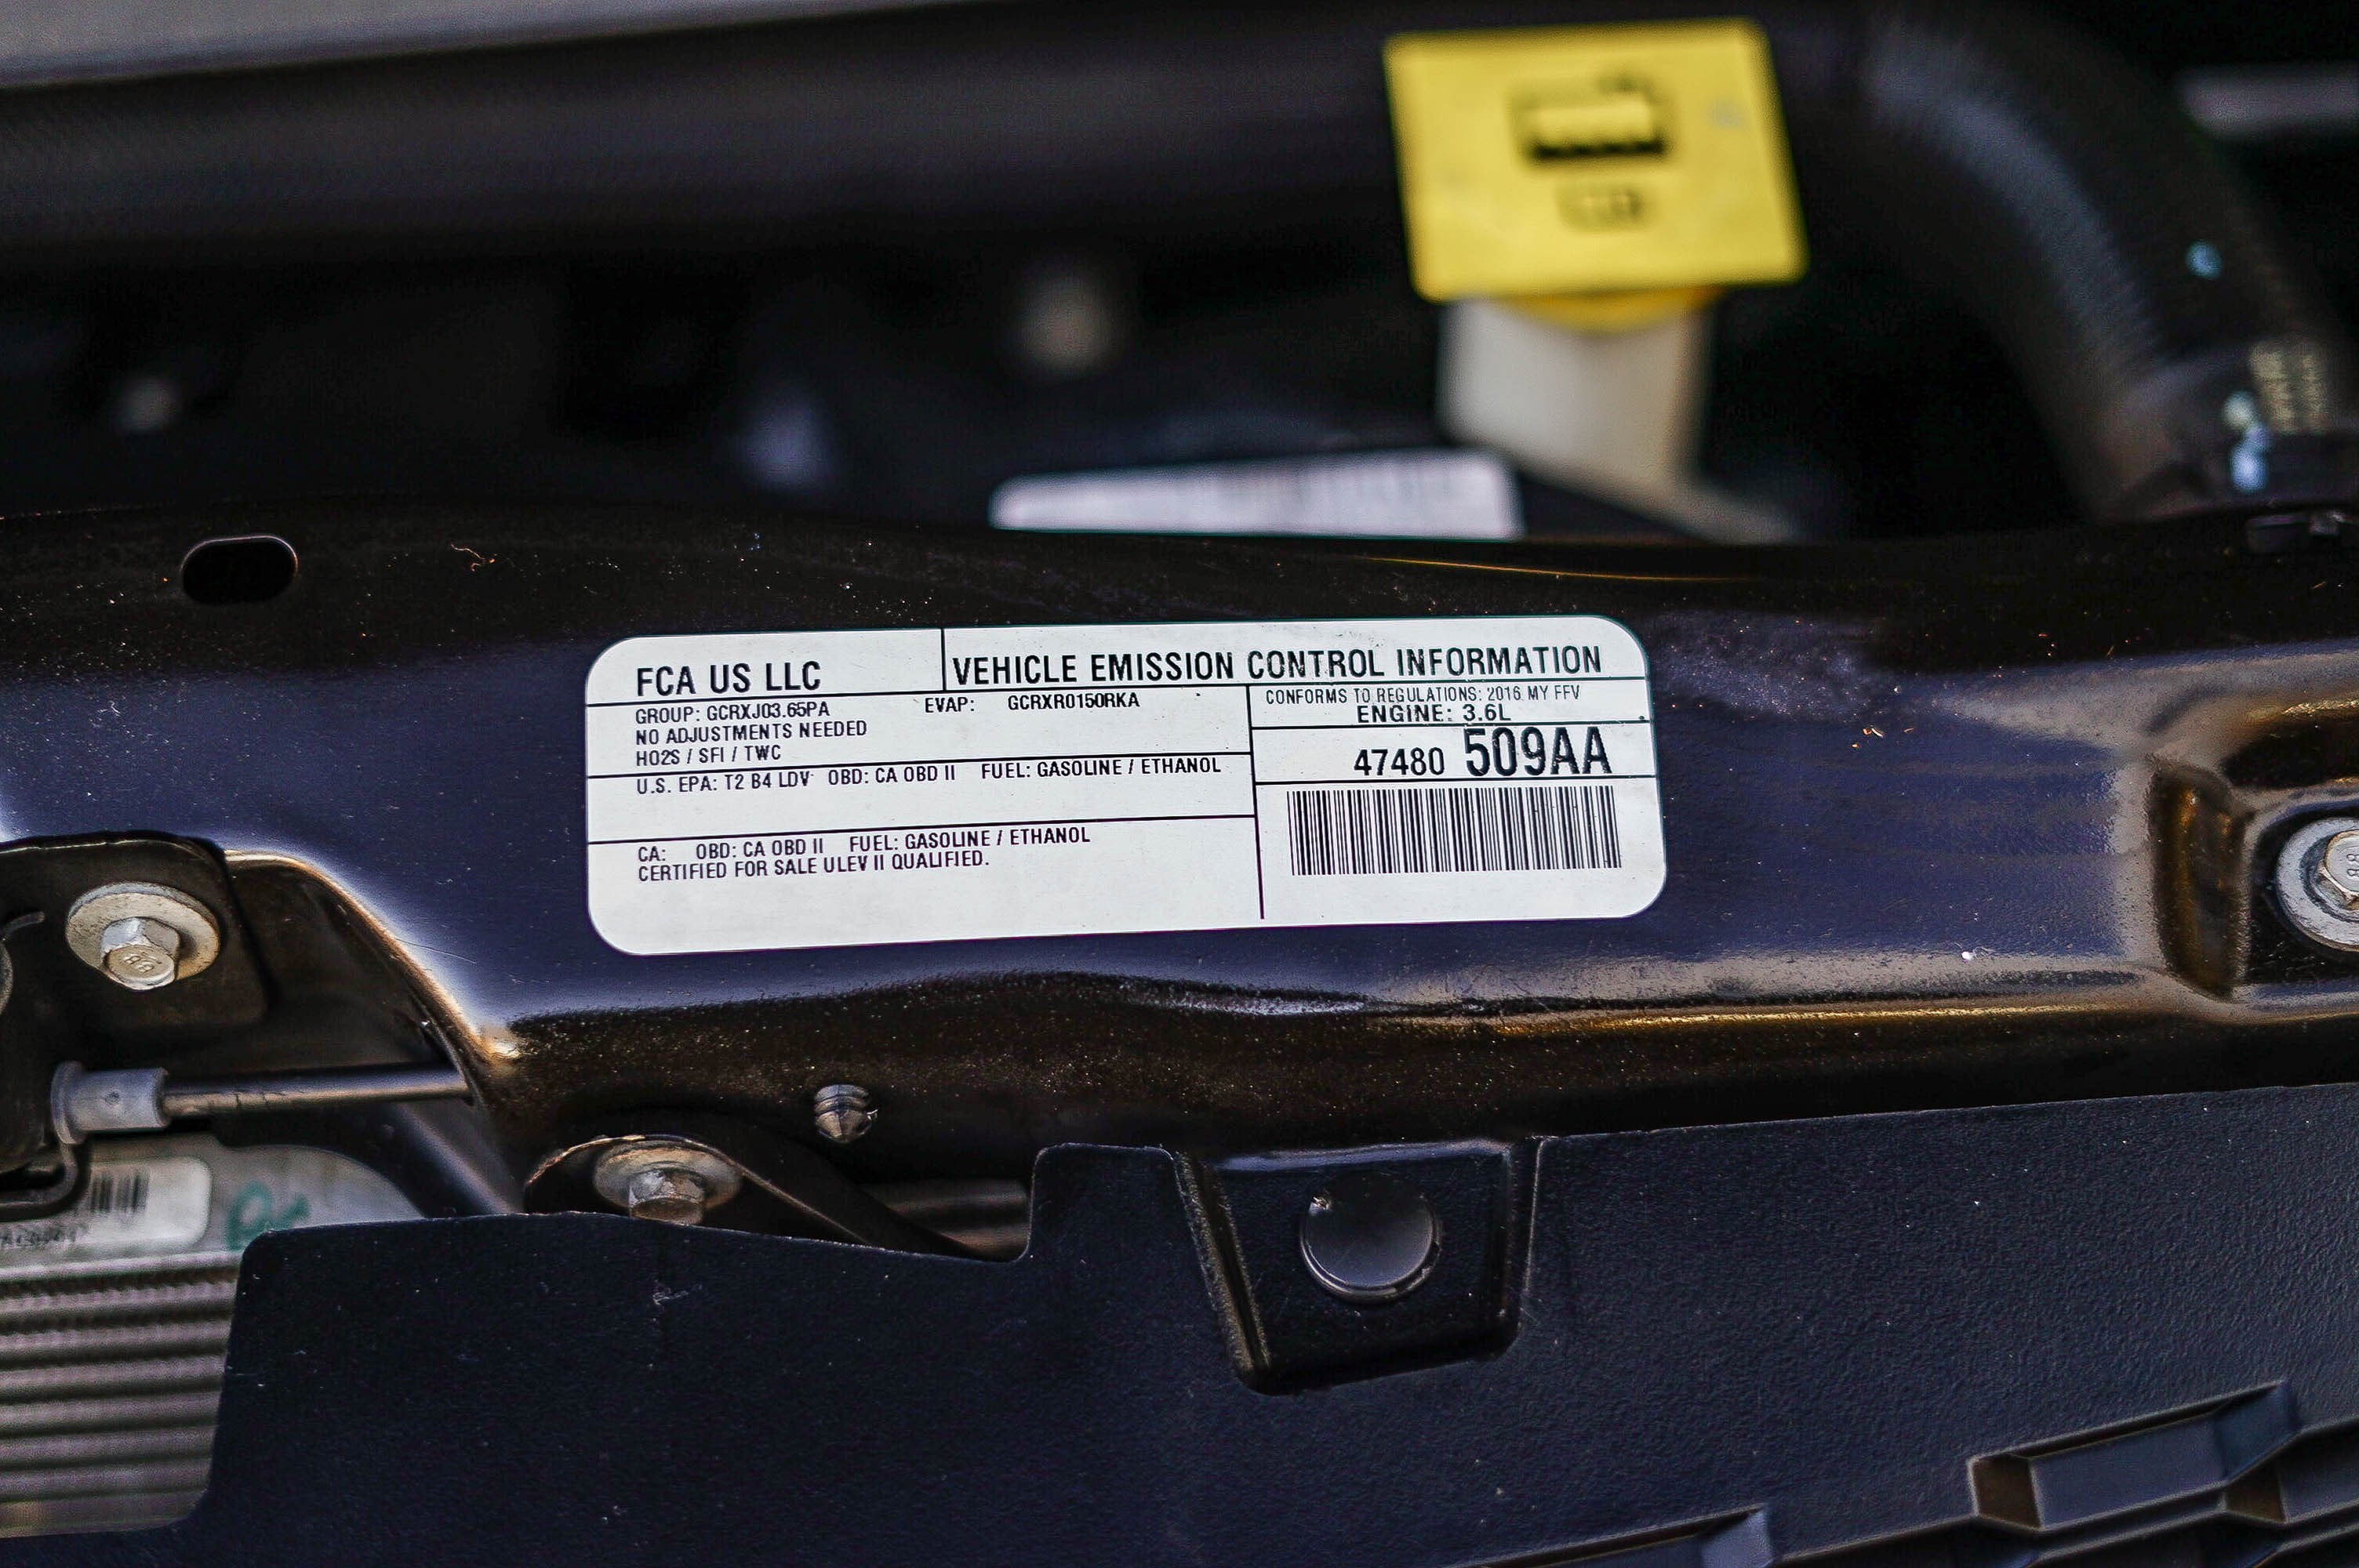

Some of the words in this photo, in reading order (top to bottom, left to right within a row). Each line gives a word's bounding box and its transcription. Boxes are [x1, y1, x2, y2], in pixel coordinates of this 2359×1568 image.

[637, 666, 696, 697] FCA
[710, 662, 751, 695] US
[765, 660, 821, 691] LLC
[951, 655, 1078, 686] VEHICLE
[1090, 651, 1234, 682] EMISSION
[1247, 648, 1385, 680] CONTROL
[1396, 645, 1601, 677] INFORMATION
[925, 696, 975, 713] EVAP:
[1007, 691, 1140, 711] GCRXR0150RKA
[1266, 688, 1347, 705] CONFORMS
[1353, 688, 1371, 703] TO
[1376, 686, 1482, 703] REGULATIONS:
[1487, 685, 1521, 702] 2016
[1527, 685, 1548, 701] MY
[1554, 684, 1579, 700] FFV
[635, 706, 700, 724] GROUP:
[707, 701, 831, 721] GCRXJ03.65PA
[1357, 703, 1452, 724] ENGINE:
[1462, 702, 1511, 722] 3.6L
[636, 728, 660, 746] NO
[665, 723, 792, 744] ADJUSTMENTS
[799, 720, 867, 739] NEEDED
[686, 748, 693, 764] /
[698, 746, 725, 764] SFI
[731, 746, 738, 762] /
[743, 744, 781, 761] TWC
[1353, 746, 1445, 776] 47480
[1463, 726, 1613, 777] 509AA
[637, 777, 671, 795] U.S.
[678, 775, 718, 793] EPA:
[724, 773, 745, 790] T2
[751, 772, 772, 789] B4
[779, 770, 811, 788] LDV
[828, 768, 869, 786] OBD:
[875, 767, 898, 784] CA
[903, 765, 938, 782] OBD
[944, 764, 955, 781] II
[981, 762, 1030, 779] FUEL:
[1037, 759, 1122, 778] GASOLINE
[1128, 758, 1135, 775] /
[1141, 757, 1222, 775] ETHANOL
[638, 845, 666, 862] CA:
[696, 842, 736, 860] OBD:
[743, 840, 766, 858] CA
[772, 838, 806, 856] OBD
[812, 837, 823, 855] II
[849, 834, 899, 852] FUEL:
[904, 829, 990, 850] GASOLINE
[996, 829, 1003, 846] /
[1009, 826, 1091, 846] ETHANOL
[638, 862, 727, 882] CERTIFIED
[735, 860, 768, 877] FOR
[774, 857, 817, 876] SALE
[823, 855, 868, 873] ULEV
[874, 854, 885, 871] II
[892, 850, 990, 870] QUALIFIED.
